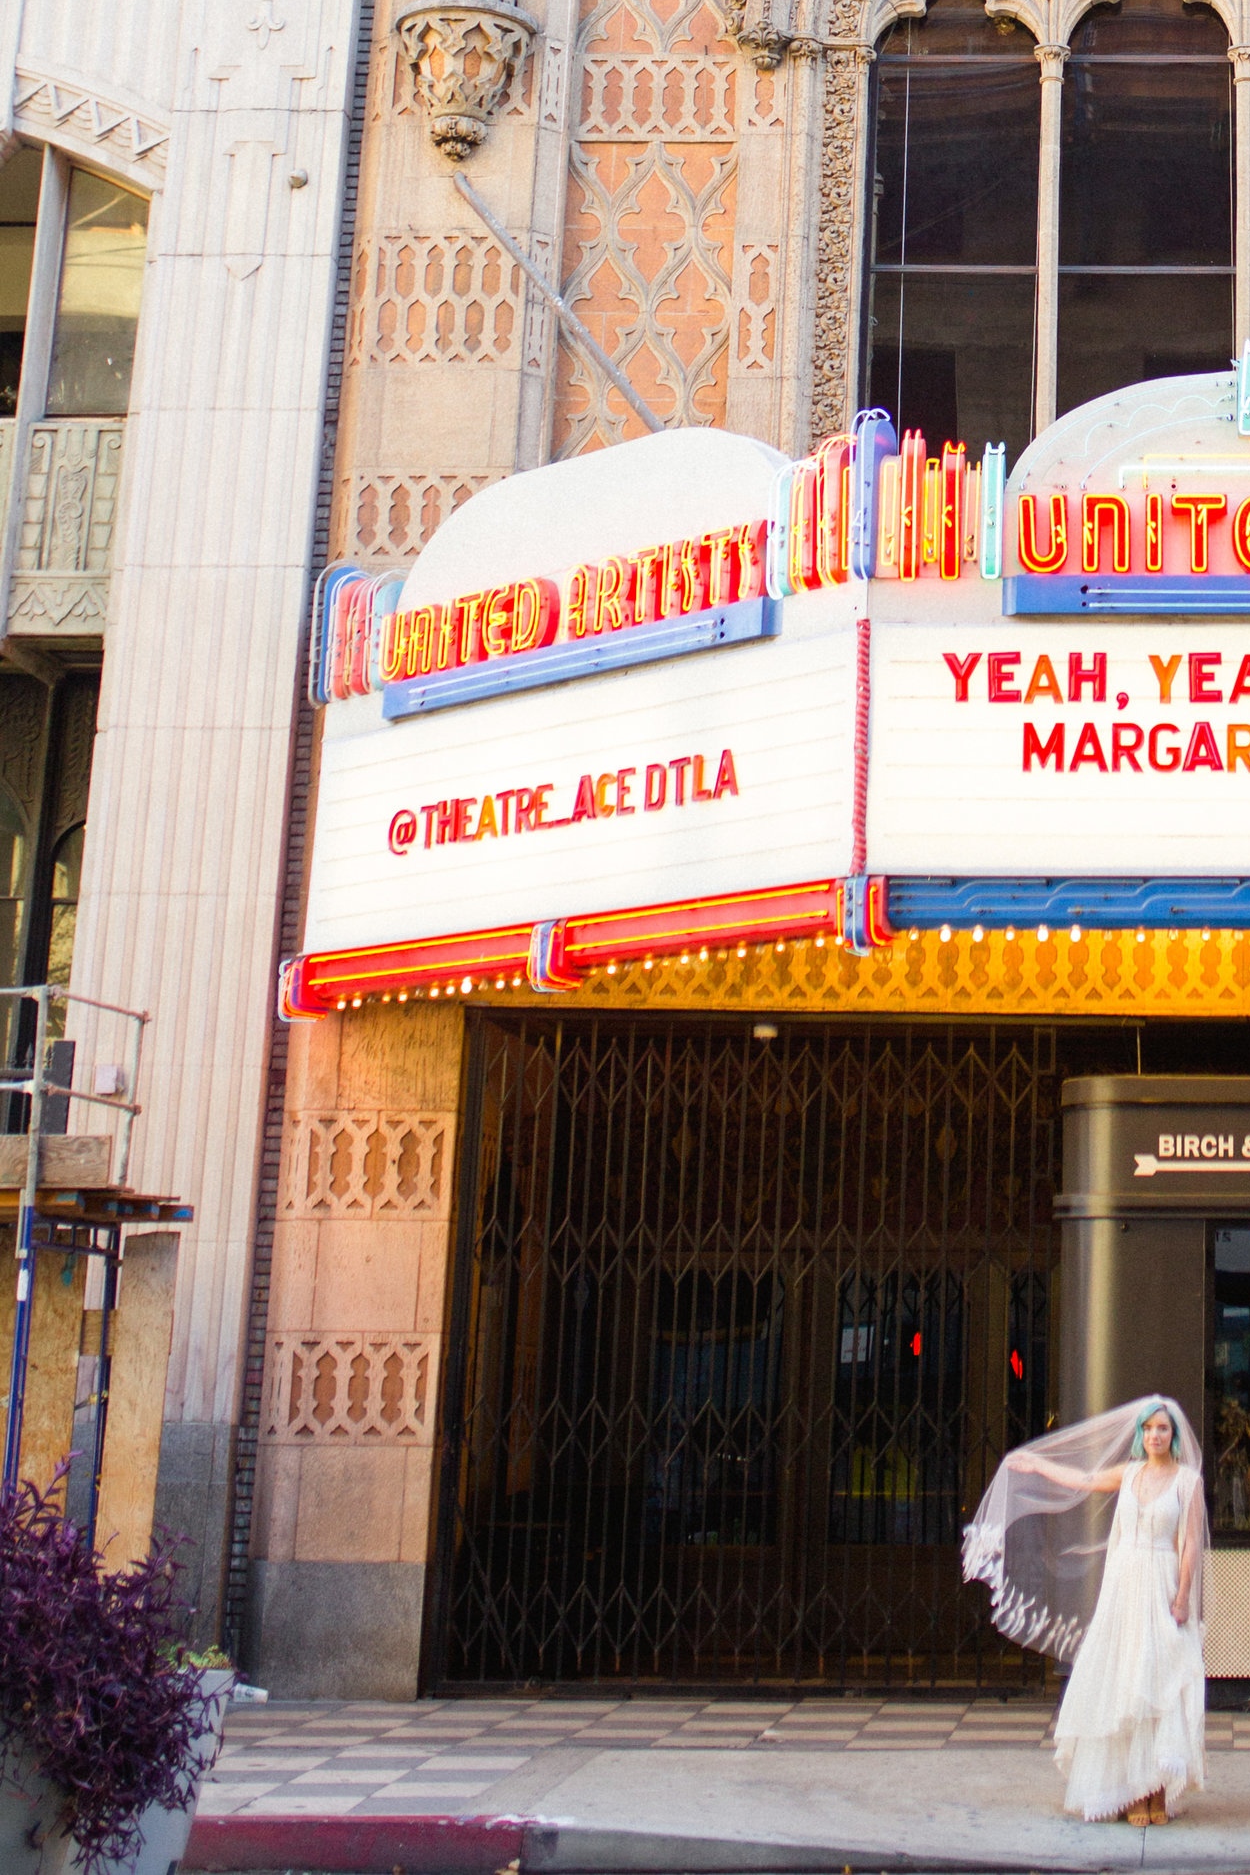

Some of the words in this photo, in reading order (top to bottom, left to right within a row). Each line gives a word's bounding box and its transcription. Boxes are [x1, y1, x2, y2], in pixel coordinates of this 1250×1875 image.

[379, 577, 557, 683] UNITED
[560, 519, 767, 642] ARTISTS
[942, 651, 1130, 710] YEAH,
[1158, 1134, 1235, 1158] BIRCH
